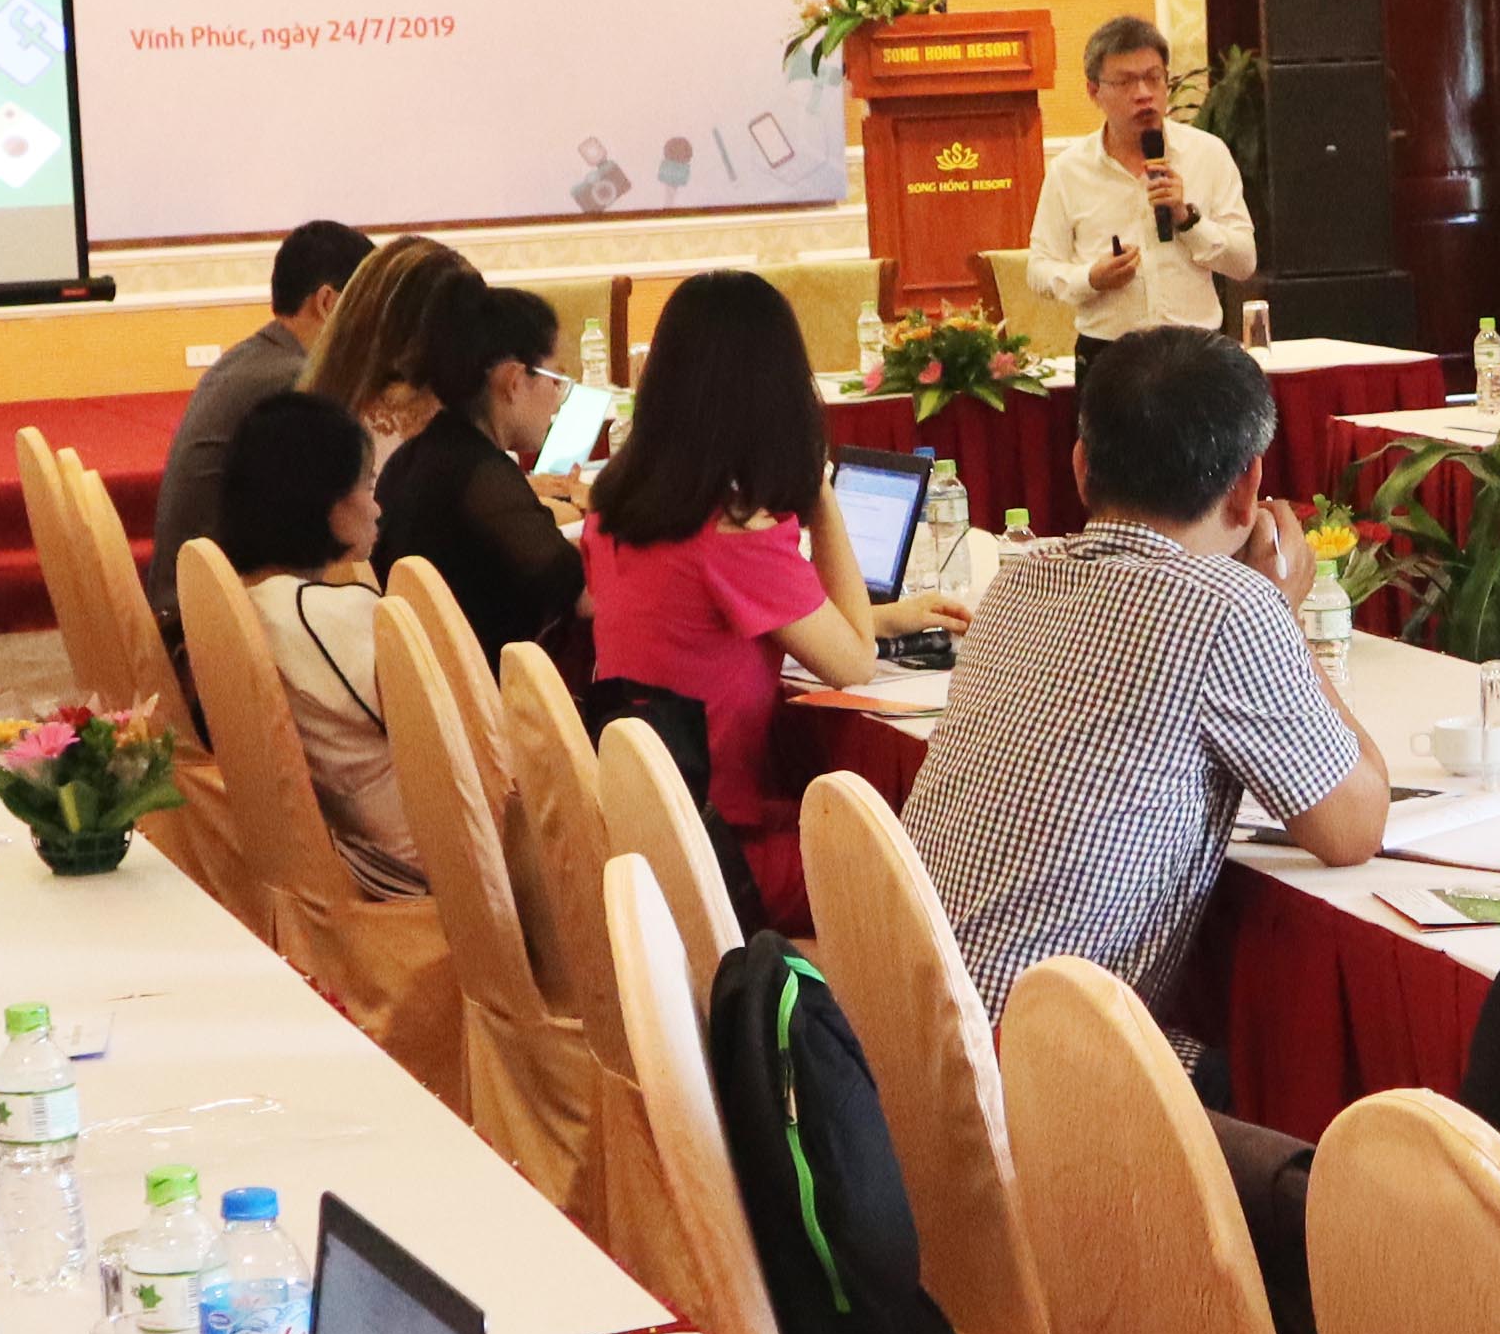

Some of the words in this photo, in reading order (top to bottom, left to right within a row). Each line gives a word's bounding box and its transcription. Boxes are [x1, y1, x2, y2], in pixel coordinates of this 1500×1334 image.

[130, 26, 185, 50] Vĩnh
[191, 24, 256, 50] Phúc,
[262, 24, 320, 50] ngày
[327, 15, 456, 45] 24/7/2019
[883, 47, 920, 63] SONG
[967, 41, 1020, 59] RESORT
[907, 182, 937, 194] SONG
[972, 178, 1013, 190] RESORT
